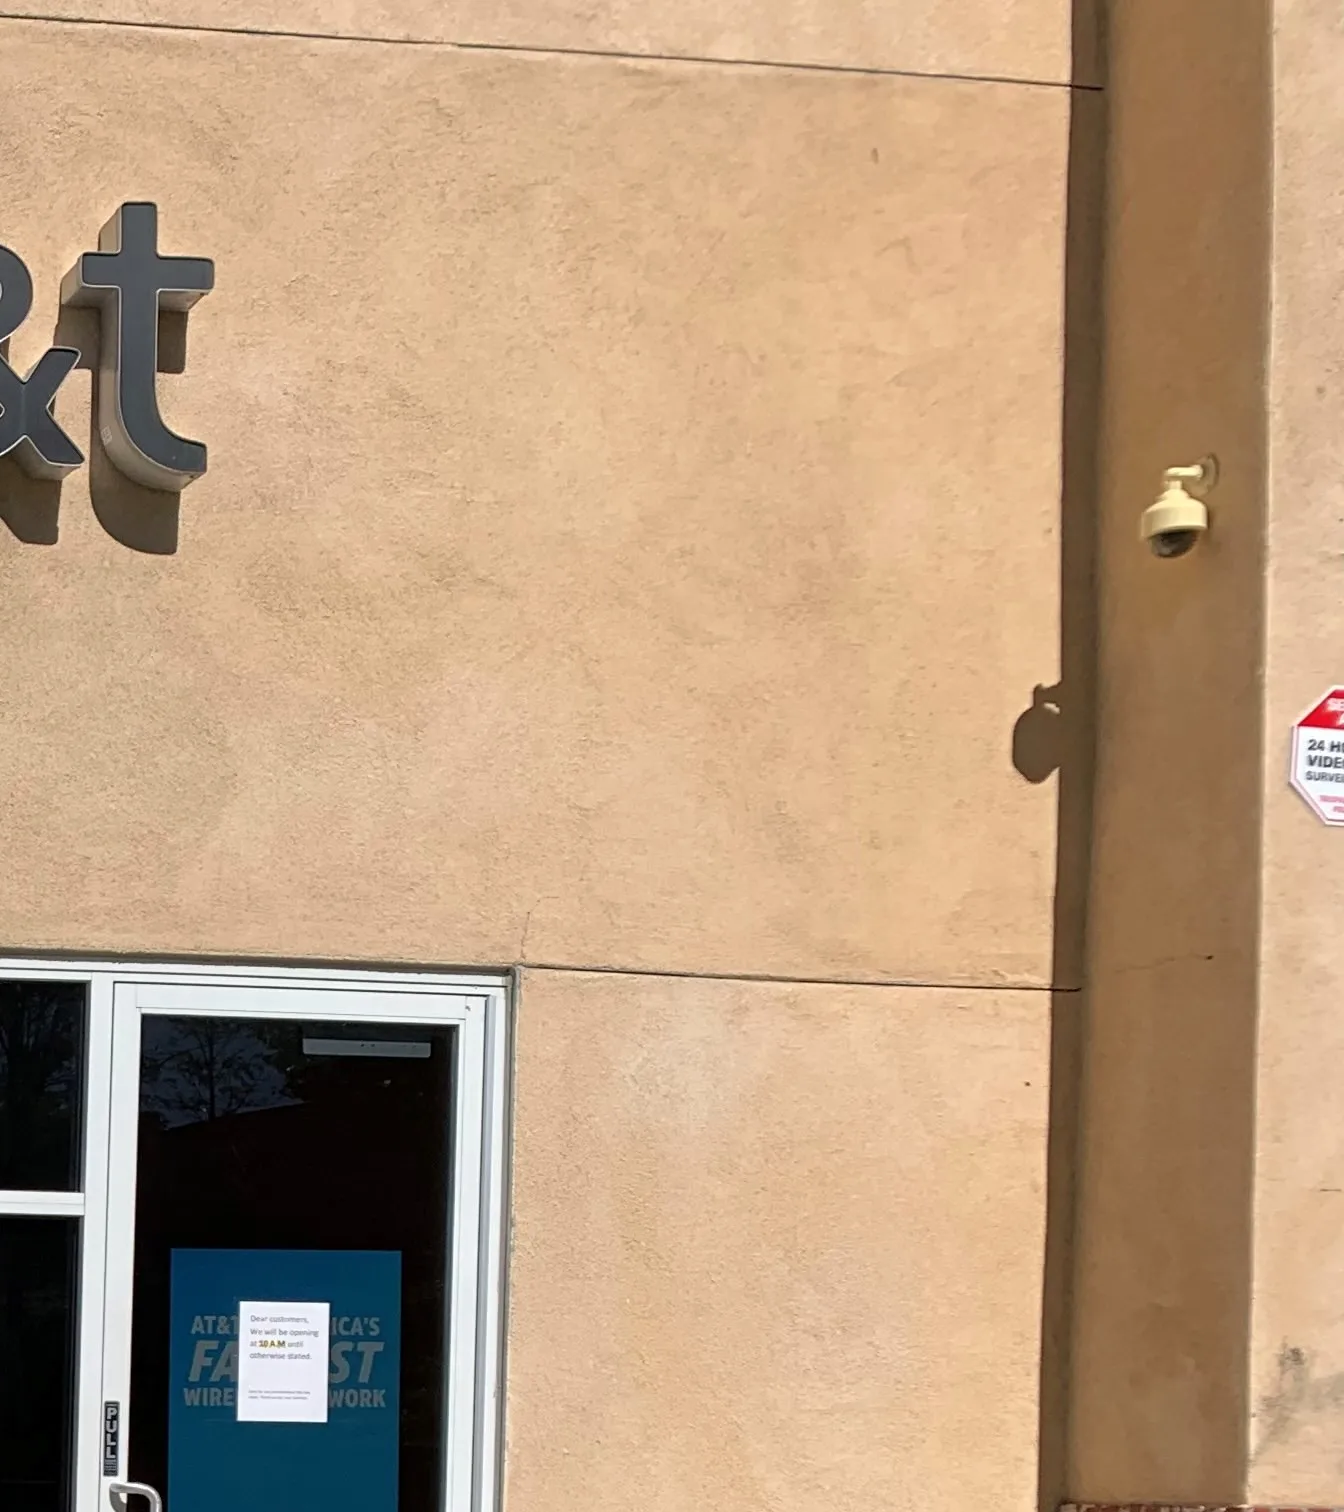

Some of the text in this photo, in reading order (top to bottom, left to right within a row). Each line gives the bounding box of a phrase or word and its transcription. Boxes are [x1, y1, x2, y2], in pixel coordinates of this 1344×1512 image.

[1307, 738, 1344, 753] 24 H
[1306, 754, 1344, 769] VIDE
[250, 1315, 268, 1323] Dear
[331, 1316, 381, 1336] ICA'S
[250, 1328, 319, 1338] We will be opening
[258, 1340, 269, 1348] 10
[288, 1340, 304, 1348] until
[249, 1352, 286, 1360] otherwise
[106, 1406, 118, 1459] PULL
